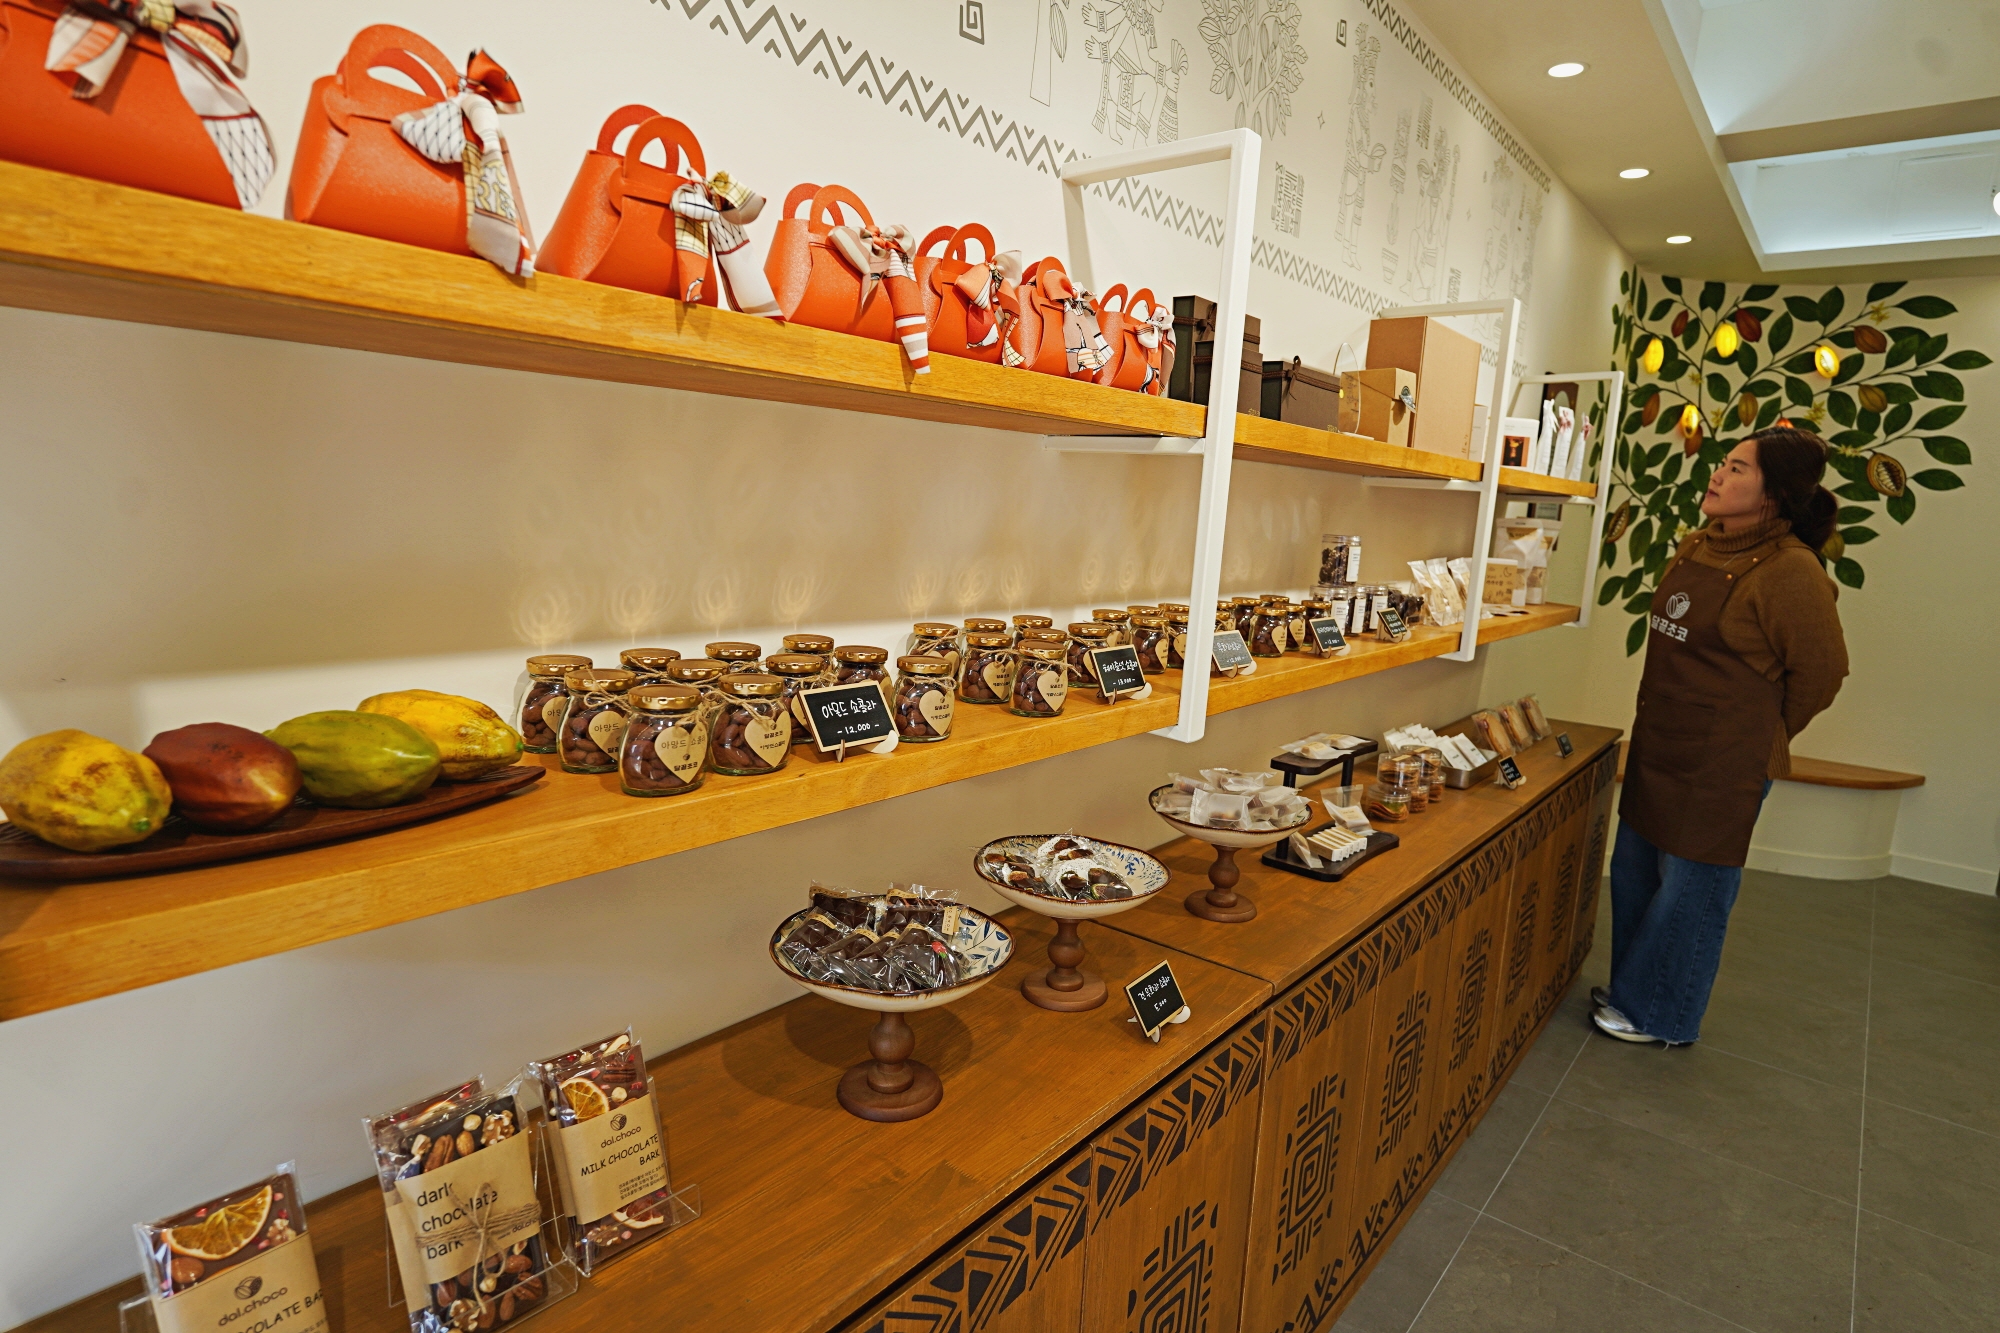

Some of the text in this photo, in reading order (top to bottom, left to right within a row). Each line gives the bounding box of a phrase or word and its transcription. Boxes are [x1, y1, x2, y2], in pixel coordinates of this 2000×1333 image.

[821, 697, 877, 719] 아몬드 쇼콜라
[594, 722, 620, 733] 아망드
[661, 739, 687, 750] 아망드
[600, 1126, 642, 1149] dal.choco
[581, 1133, 659, 1177] MILK CHOCOLATE
[639, 1148, 660, 1166] BARK
[218, 1286, 289, 1328] dal.choco
